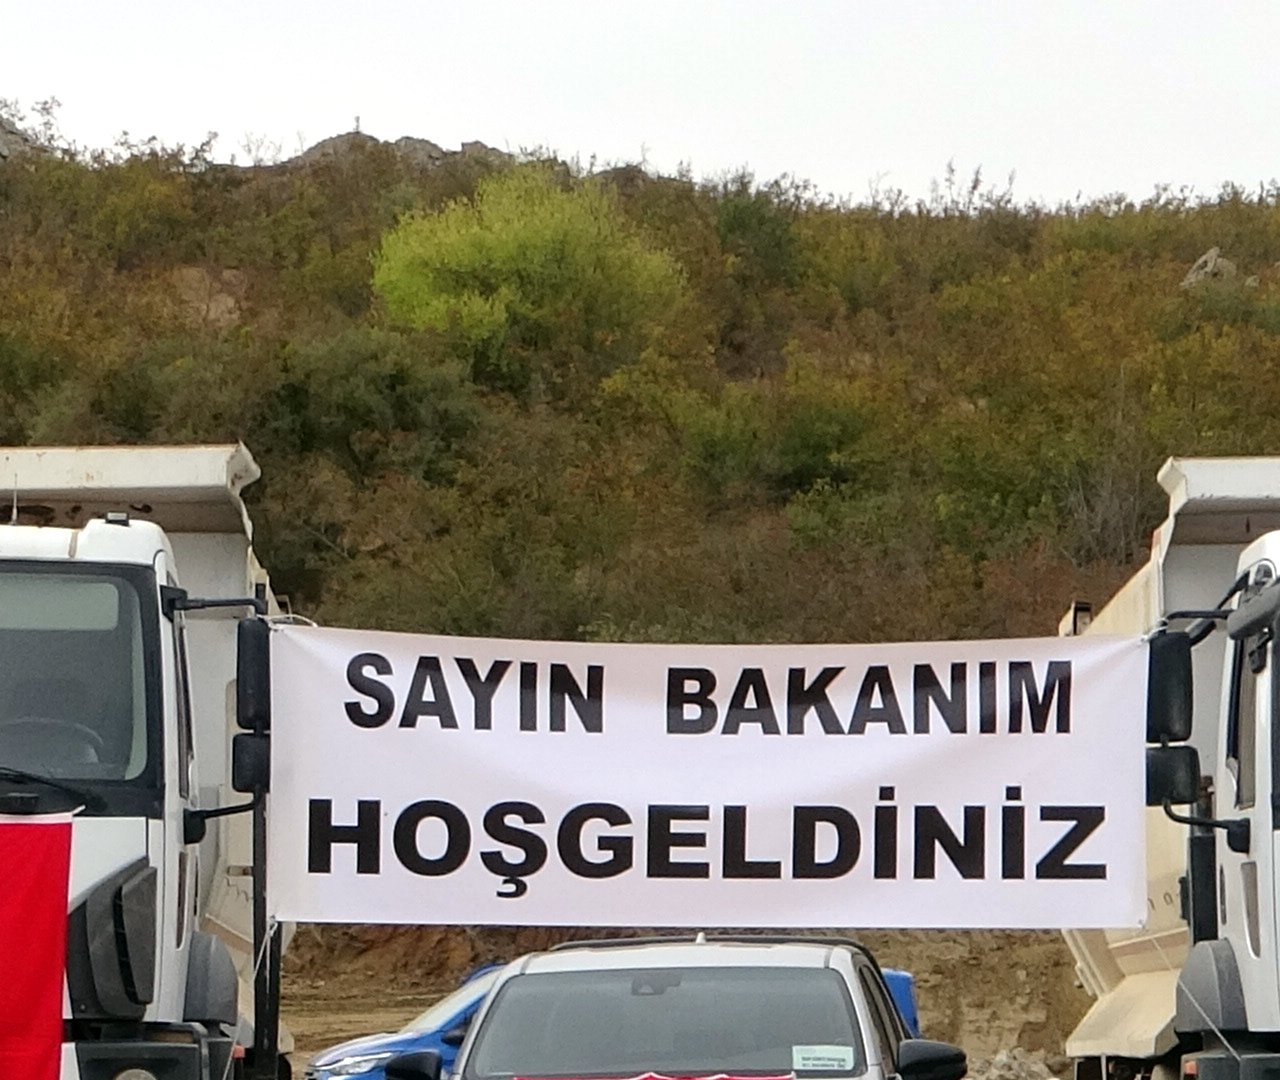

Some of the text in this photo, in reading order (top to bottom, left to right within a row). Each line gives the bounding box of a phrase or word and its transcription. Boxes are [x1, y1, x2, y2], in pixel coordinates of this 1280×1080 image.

[343, 652, 1072, 736] SAYIN BAKANIM
[307, 785, 1107, 899] HOŞGELDİNİZ
